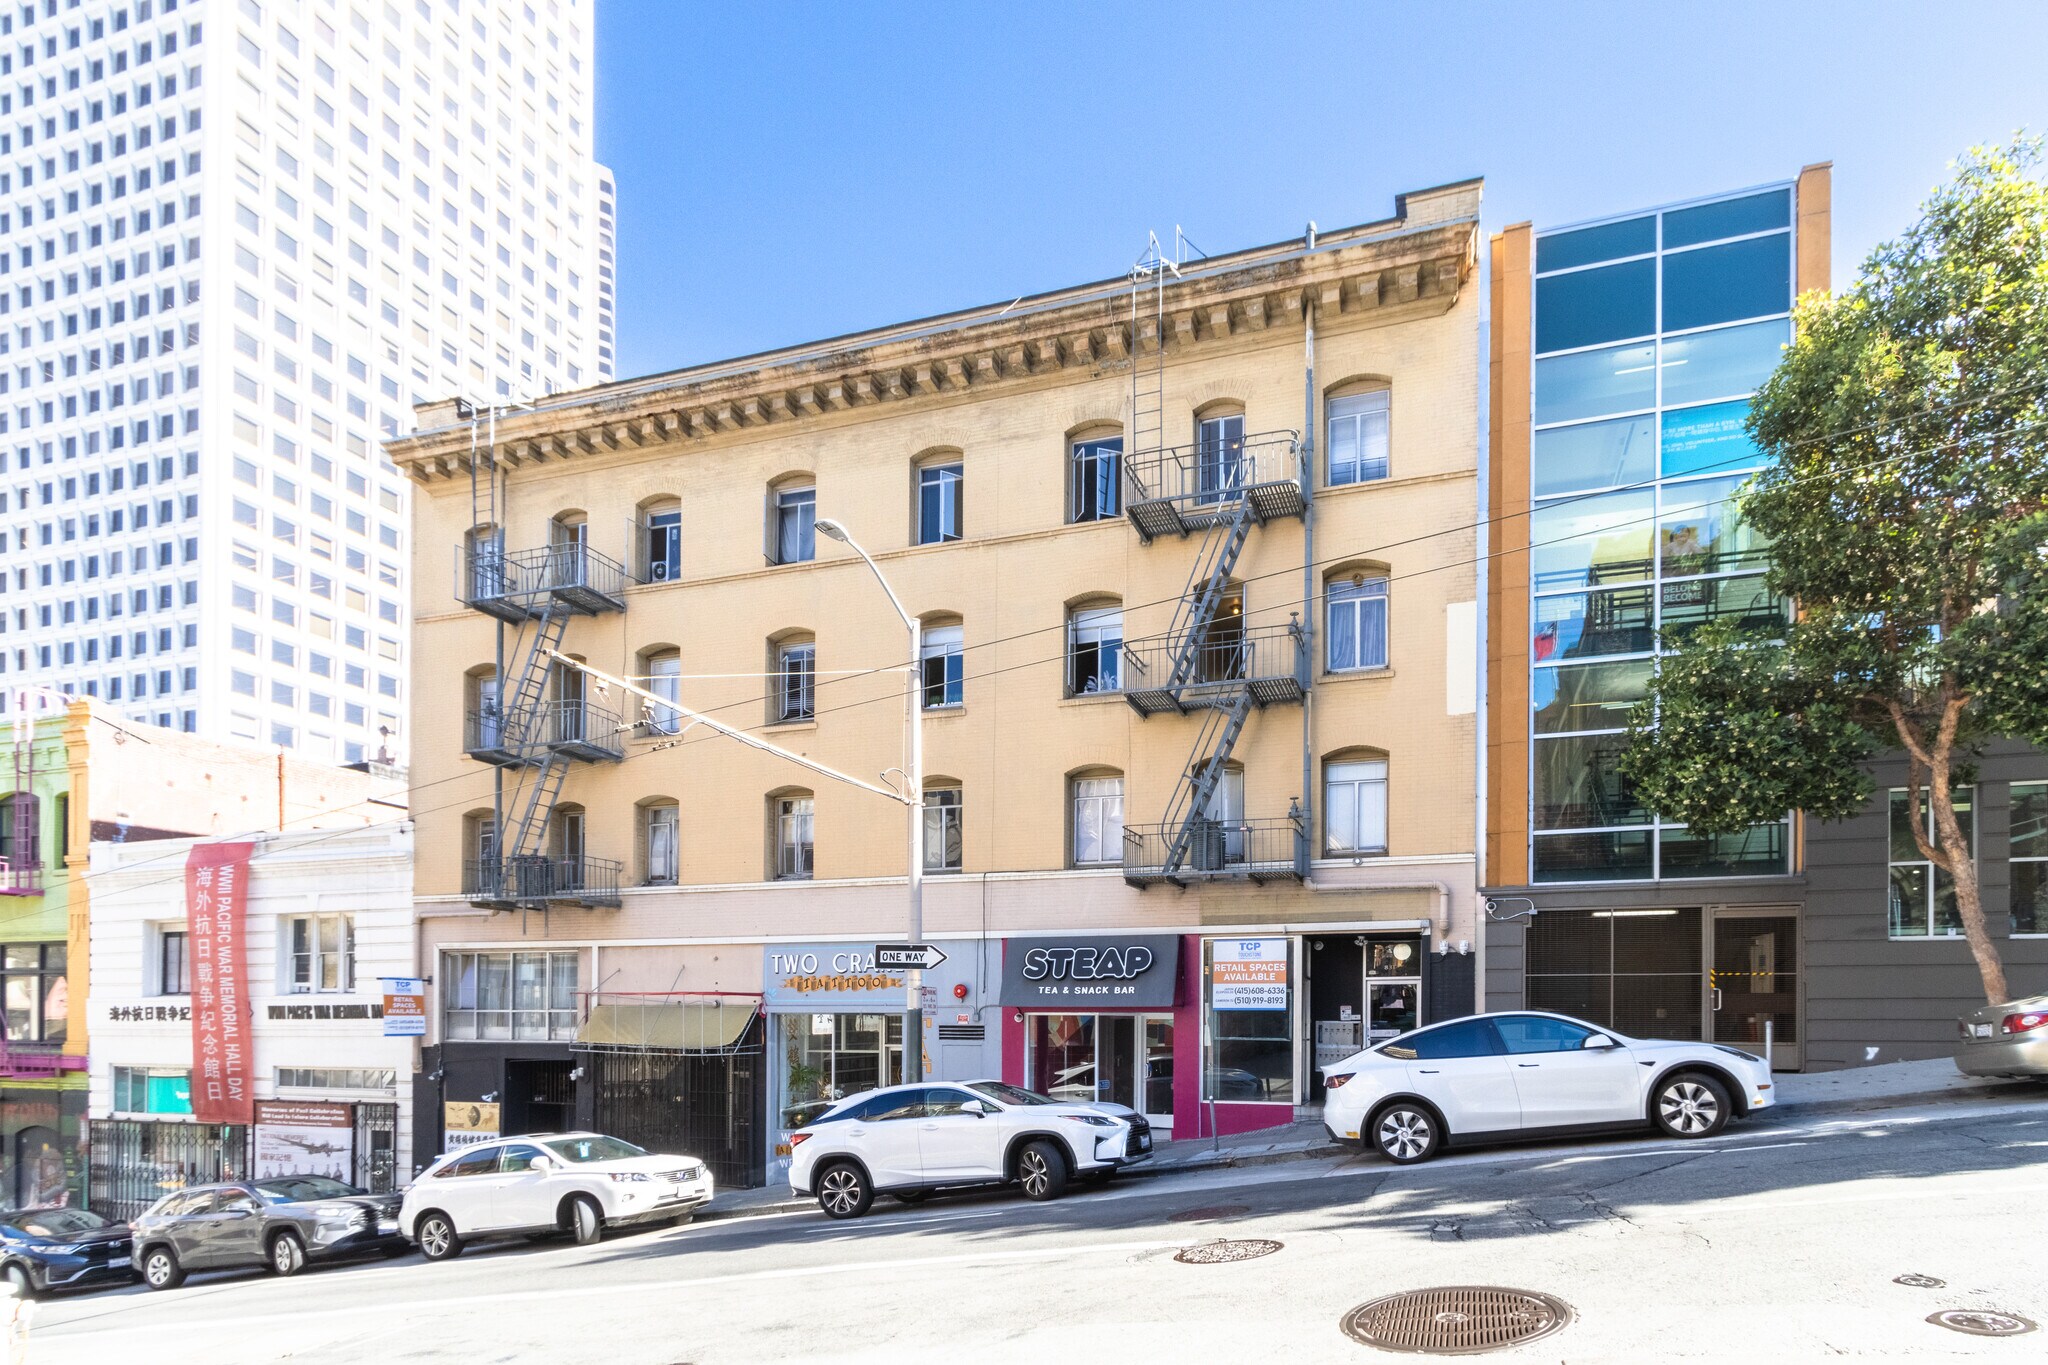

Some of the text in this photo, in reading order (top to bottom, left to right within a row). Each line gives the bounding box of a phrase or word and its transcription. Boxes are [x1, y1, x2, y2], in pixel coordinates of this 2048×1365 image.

[1664, 583, 1702, 593] BELONG
[1664, 591, 1702, 602] BECOME
[1239, 942, 1261, 951] TCP
[882, 952, 925, 962] ONE WAY
[772, 953, 905, 974] TWO CRA
[1022, 946, 1154, 980] STEAP
[1214, 963, 1286, 972] RETAIL SPACES
[1223, 973, 1276, 981] AVAILABLE
[217, 864, 243, 1101] WWII PACIFIC WAR MEMORIAL HALL DAY
[803, 977, 882, 989] TATTOO
[1039, 986, 1135, 994] TEA & SNACK BAR
